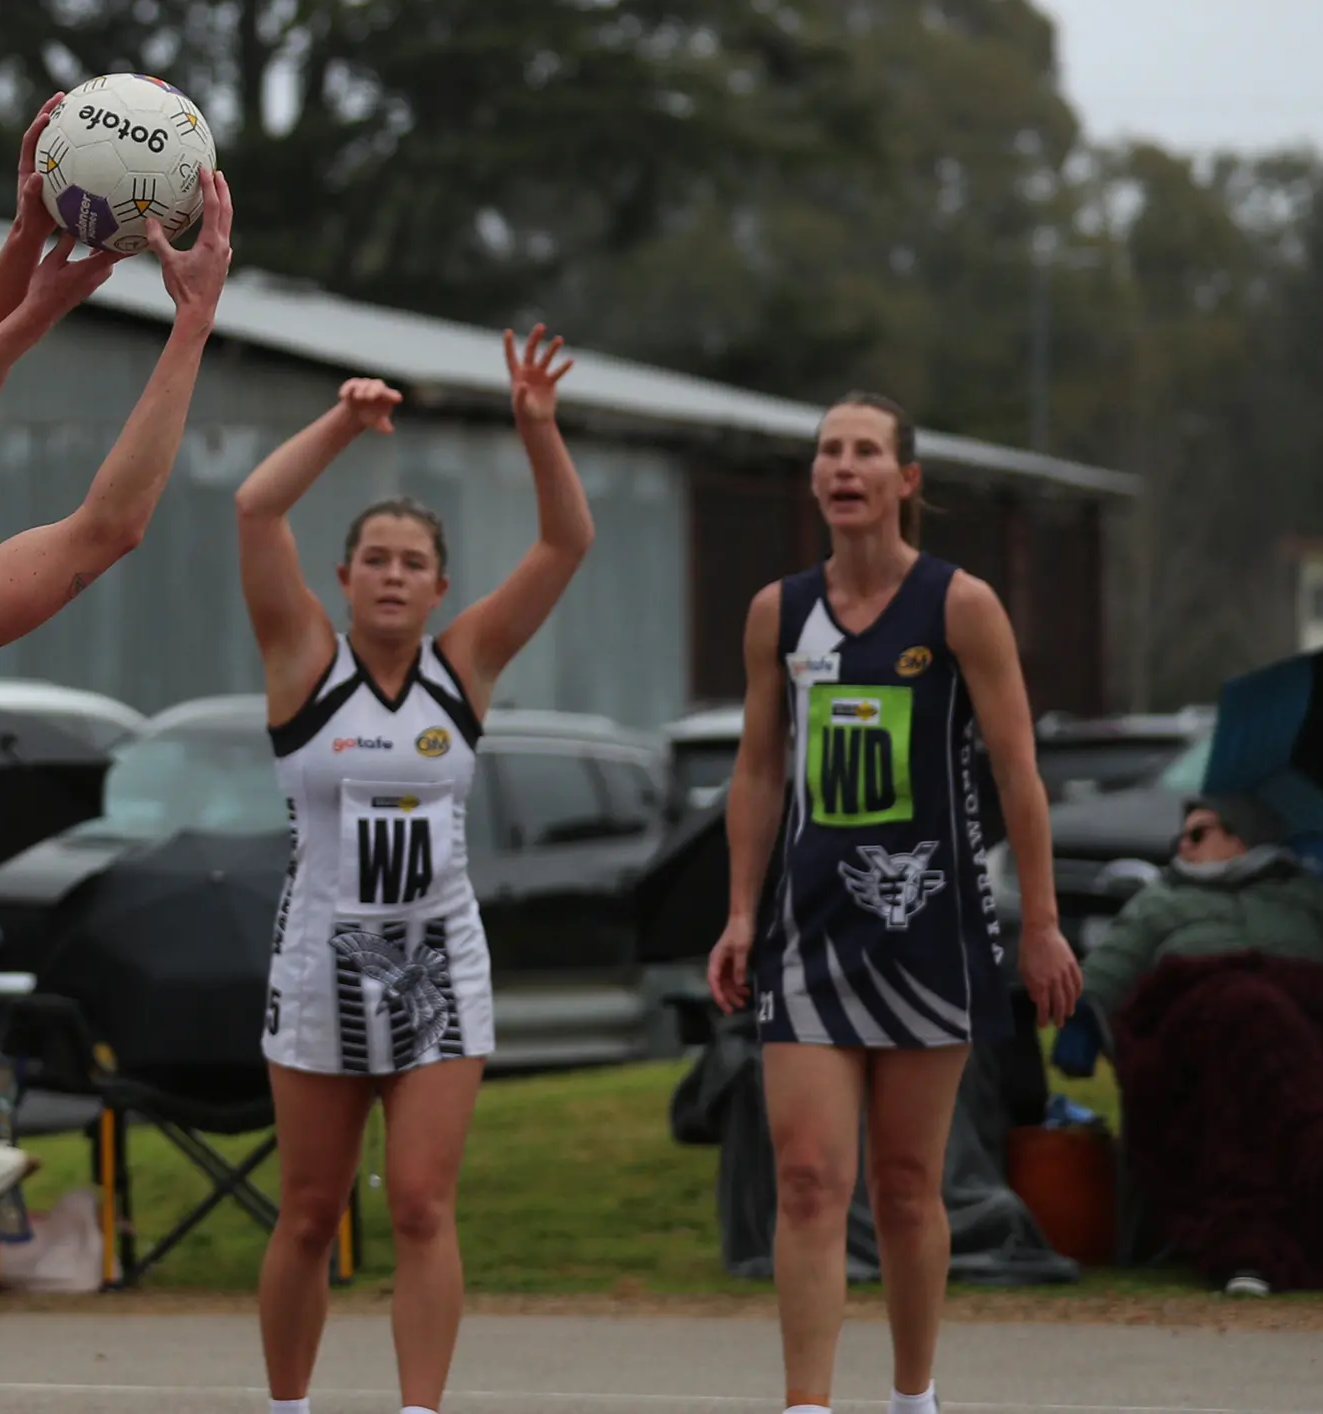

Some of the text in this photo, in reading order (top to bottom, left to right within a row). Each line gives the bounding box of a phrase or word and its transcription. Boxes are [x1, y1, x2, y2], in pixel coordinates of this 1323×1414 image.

[78, 104, 169, 153] gotafe
[821, 726, 897, 814] WD
[358, 817, 434, 904] WA
